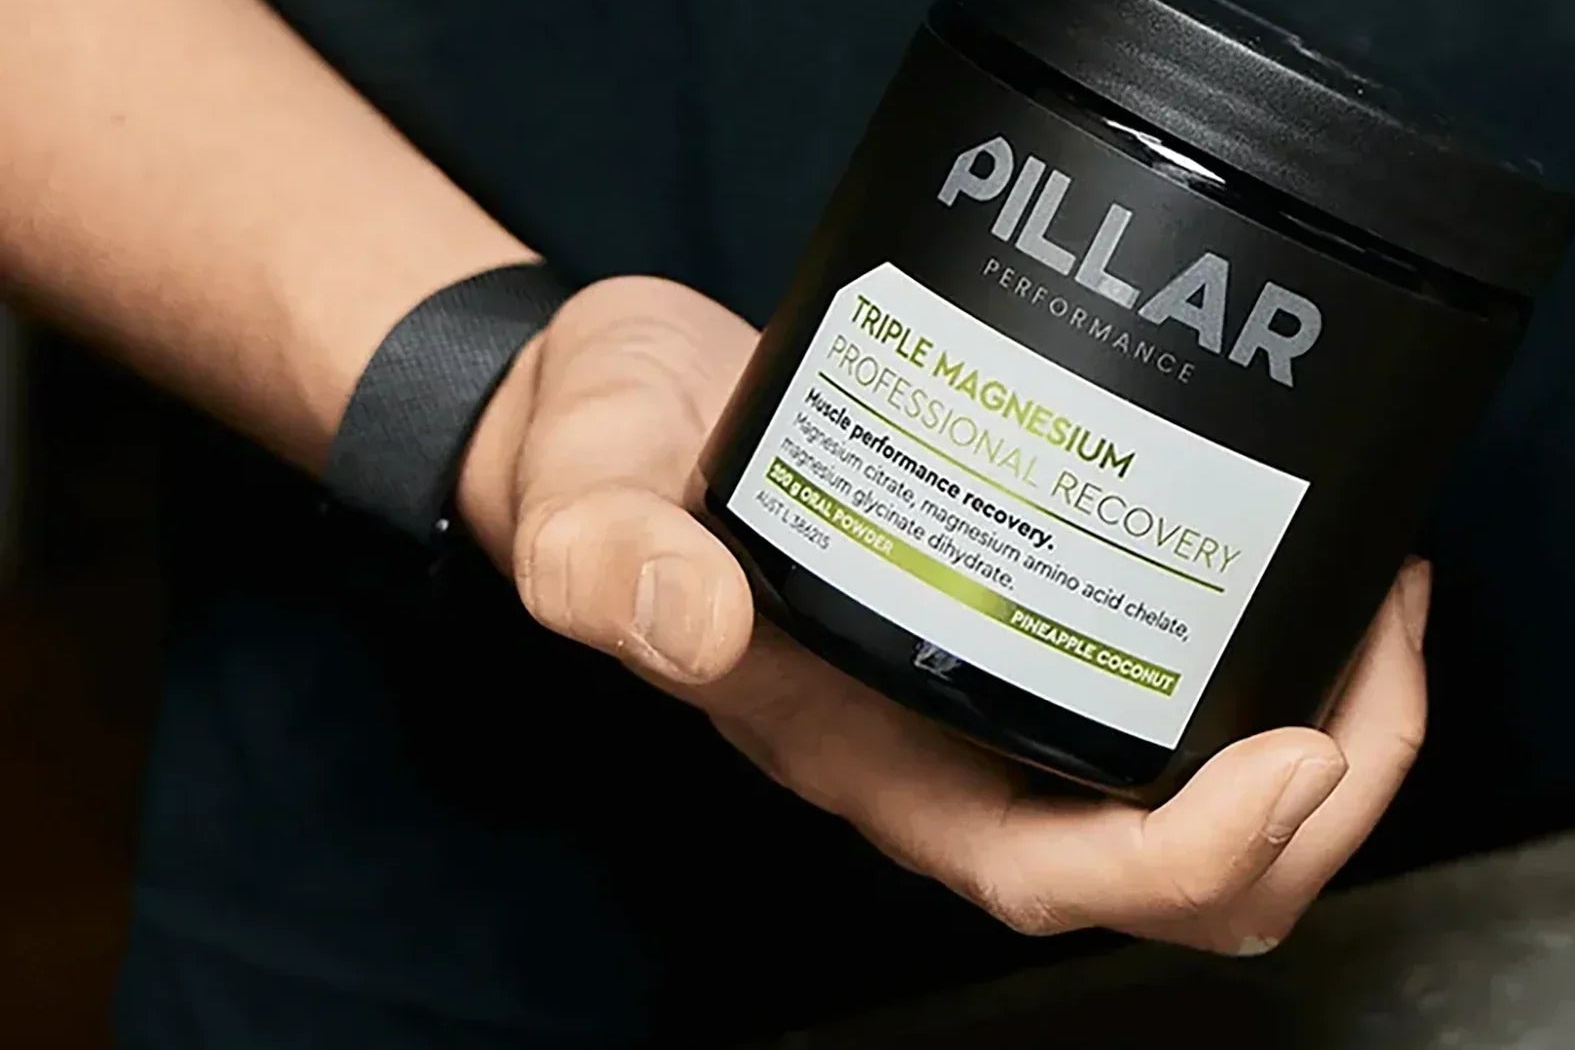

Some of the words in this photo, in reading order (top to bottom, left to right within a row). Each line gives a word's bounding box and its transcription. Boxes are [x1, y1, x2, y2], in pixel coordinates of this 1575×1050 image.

[937, 136, 1322, 387] PILLAR
[982, 258, 1195, 384] PERFORMANCE
[826, 334, 1037, 488] PROFESSIONAL
[1051, 470, 1241, 573] RECOVERY
[851, 294, 934, 368] TRIPLE
[932, 351, 1135, 478] MAGNESIUM
[781, 437, 852, 496] magnesium
[853, 488, 926, 539] glycinate
[927, 532, 1014, 591] dihydrate.
[793, 411, 863, 472] Magnesium
[864, 462, 917, 509] citrate,
[920, 498, 1021, 562] magnesium
[1023, 554, 1080, 591] amino
[1082, 583, 1125, 611] acid
[1124, 602, 1190, 642] chelate,
[800, 486, 832, 517] ORAL
[832, 509, 894, 554] POWDER
[805, 387, 851, 430] Muscle
[850, 422, 960, 499] performance
[963, 491, 1054, 550] recovery.
[1010, 610, 1096, 659] PINEAPPLE
[1096, 650, 1174, 691] COCONUT
